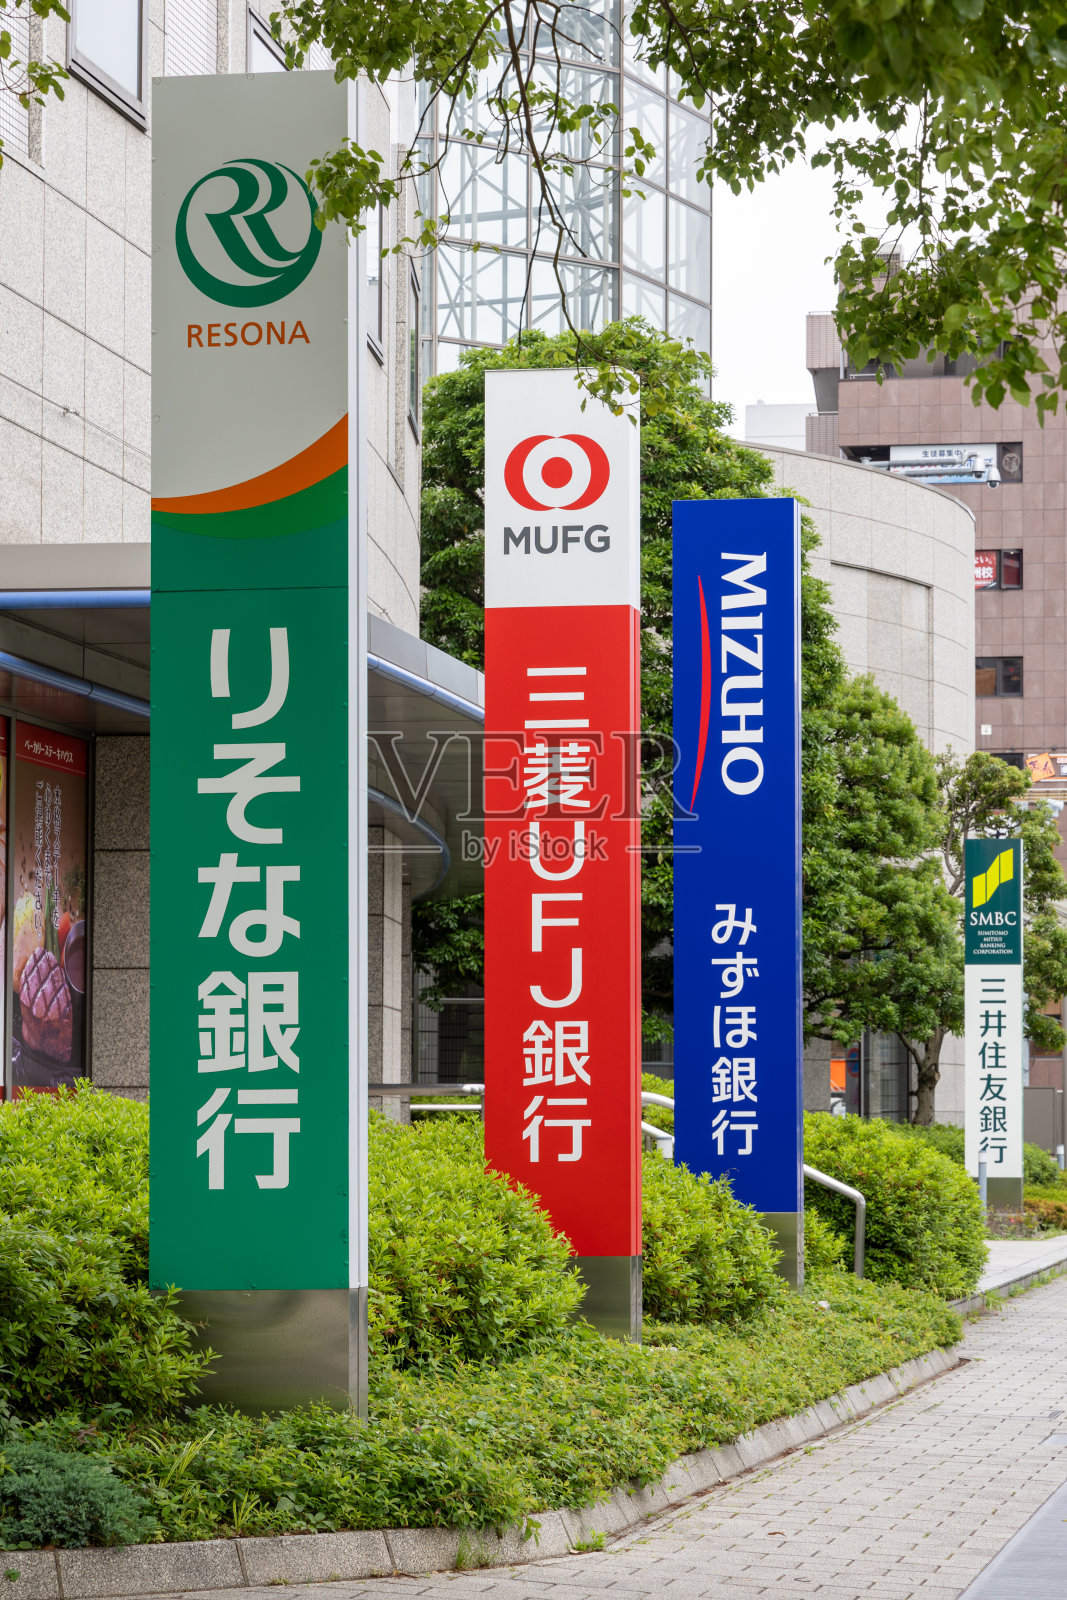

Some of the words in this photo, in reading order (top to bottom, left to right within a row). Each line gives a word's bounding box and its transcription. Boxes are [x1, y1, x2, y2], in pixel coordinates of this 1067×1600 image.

[187, 320, 311, 348] RESONA
[503, 524, 611, 555] MUFG
[720, 552, 767, 796] MIZUHO
[197, 627, 301, 1190] りそな銀行
[522, 666, 592, 1163] 三菱UFJ銀行
[970, 911, 1017, 926] SMBC
[711, 903, 760, 1156] みずほ銀行
[978, 978, 1008, 1164] 三井住友銀行
